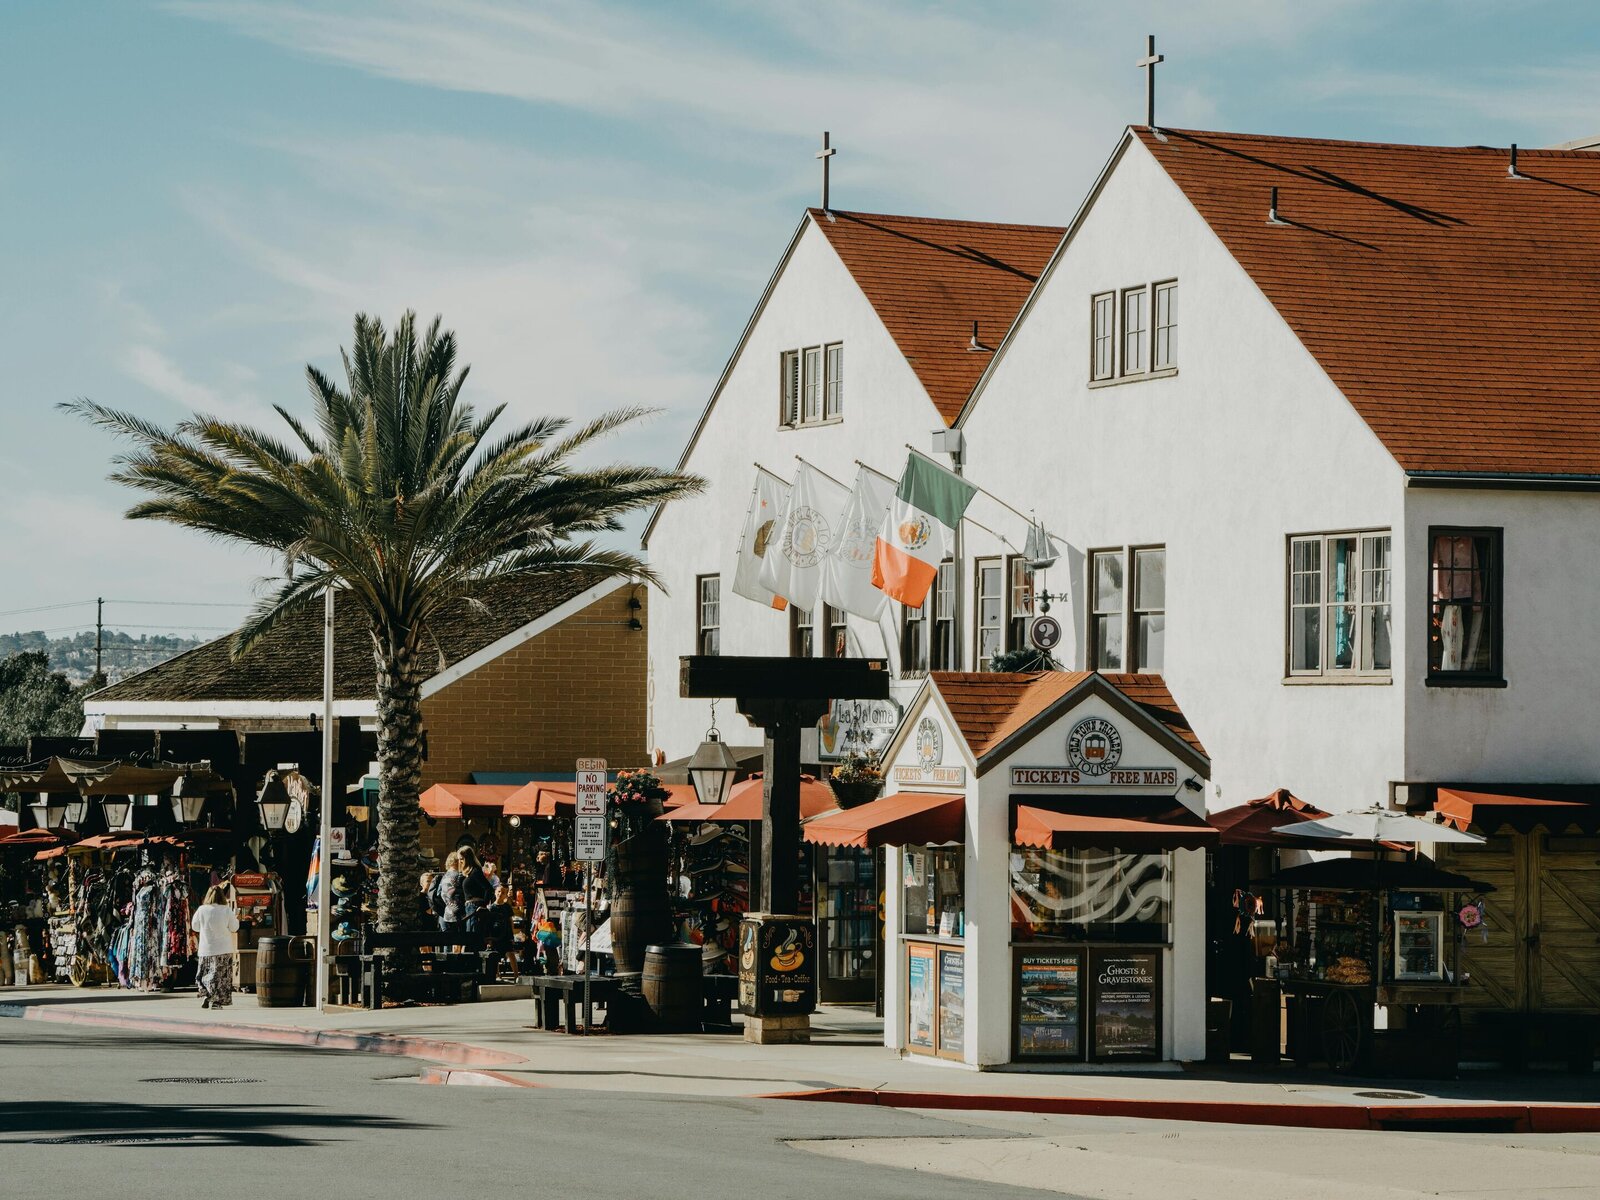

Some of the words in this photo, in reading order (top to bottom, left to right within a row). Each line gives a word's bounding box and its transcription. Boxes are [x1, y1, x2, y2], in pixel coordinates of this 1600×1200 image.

[838, 703, 851, 723] La
[852, 703, 893, 723] Paloma
[1074, 720, 1096, 737] TOWN
[1070, 737, 1080, 752] OLD
[1099, 721, 1121, 754] TROLLEY
[578, 761, 605, 770] BEGIN
[585, 774, 598, 783] NO
[895, 767, 922, 780] TICKETS
[934, 769, 946, 781] FREE
[947, 769, 960, 781] MAPS
[1014, 770, 1080, 783] TICKETS
[1110, 771, 1140, 784] FREE
[1143, 771, 1175, 784] MAPS
[578, 784, 605, 793] PARKING
[764, 975, 778, 983] Food
[781, 974, 791, 983] Tea
[794, 974, 811, 983] Coffee
